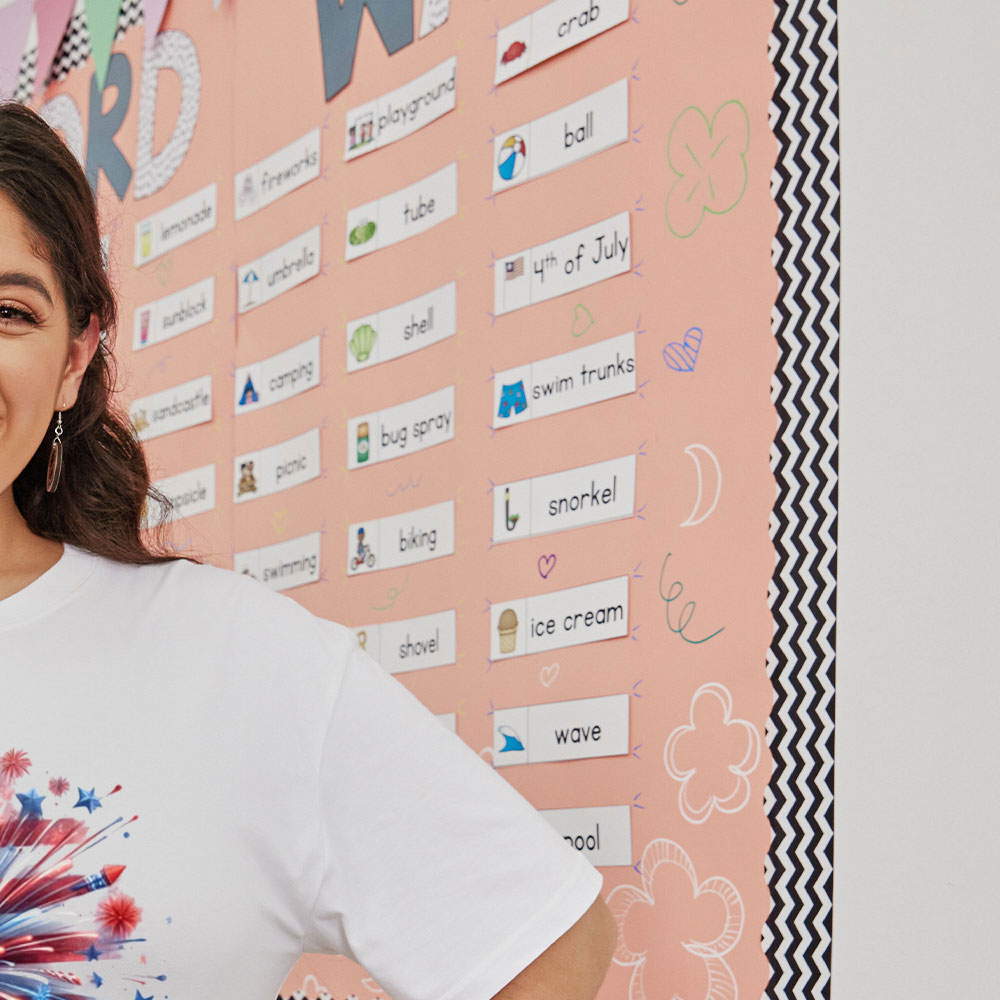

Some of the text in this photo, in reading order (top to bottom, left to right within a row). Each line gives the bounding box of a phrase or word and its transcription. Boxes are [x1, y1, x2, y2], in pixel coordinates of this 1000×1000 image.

[557, 1, 601, 38] crab
[377, 66, 456, 136] playground
[563, 111, 594, 149] ball
[261, 147, 318, 194] fireworks
[160, 200, 213, 241] lemonade
[404, 194, 436, 226] tube
[266, 246, 315, 288] umbrella
[533, 229, 630, 284] 4th of July
[162, 290, 209, 330] sunblock
[403, 305, 434, 341] shell
[269, 360, 314, 393] camping
[531, 351, 636, 401] swim trunks
[380, 409, 452, 449] bug spray
[276, 454, 308, 486] picnic
[548, 474, 618, 517] snorkel
[399, 525, 437, 553] biking
[262, 553, 318, 583] swimming
[531, 603, 624, 639] ice cream
[398, 626, 440, 660] shovel
[554, 724, 602, 745] wave
